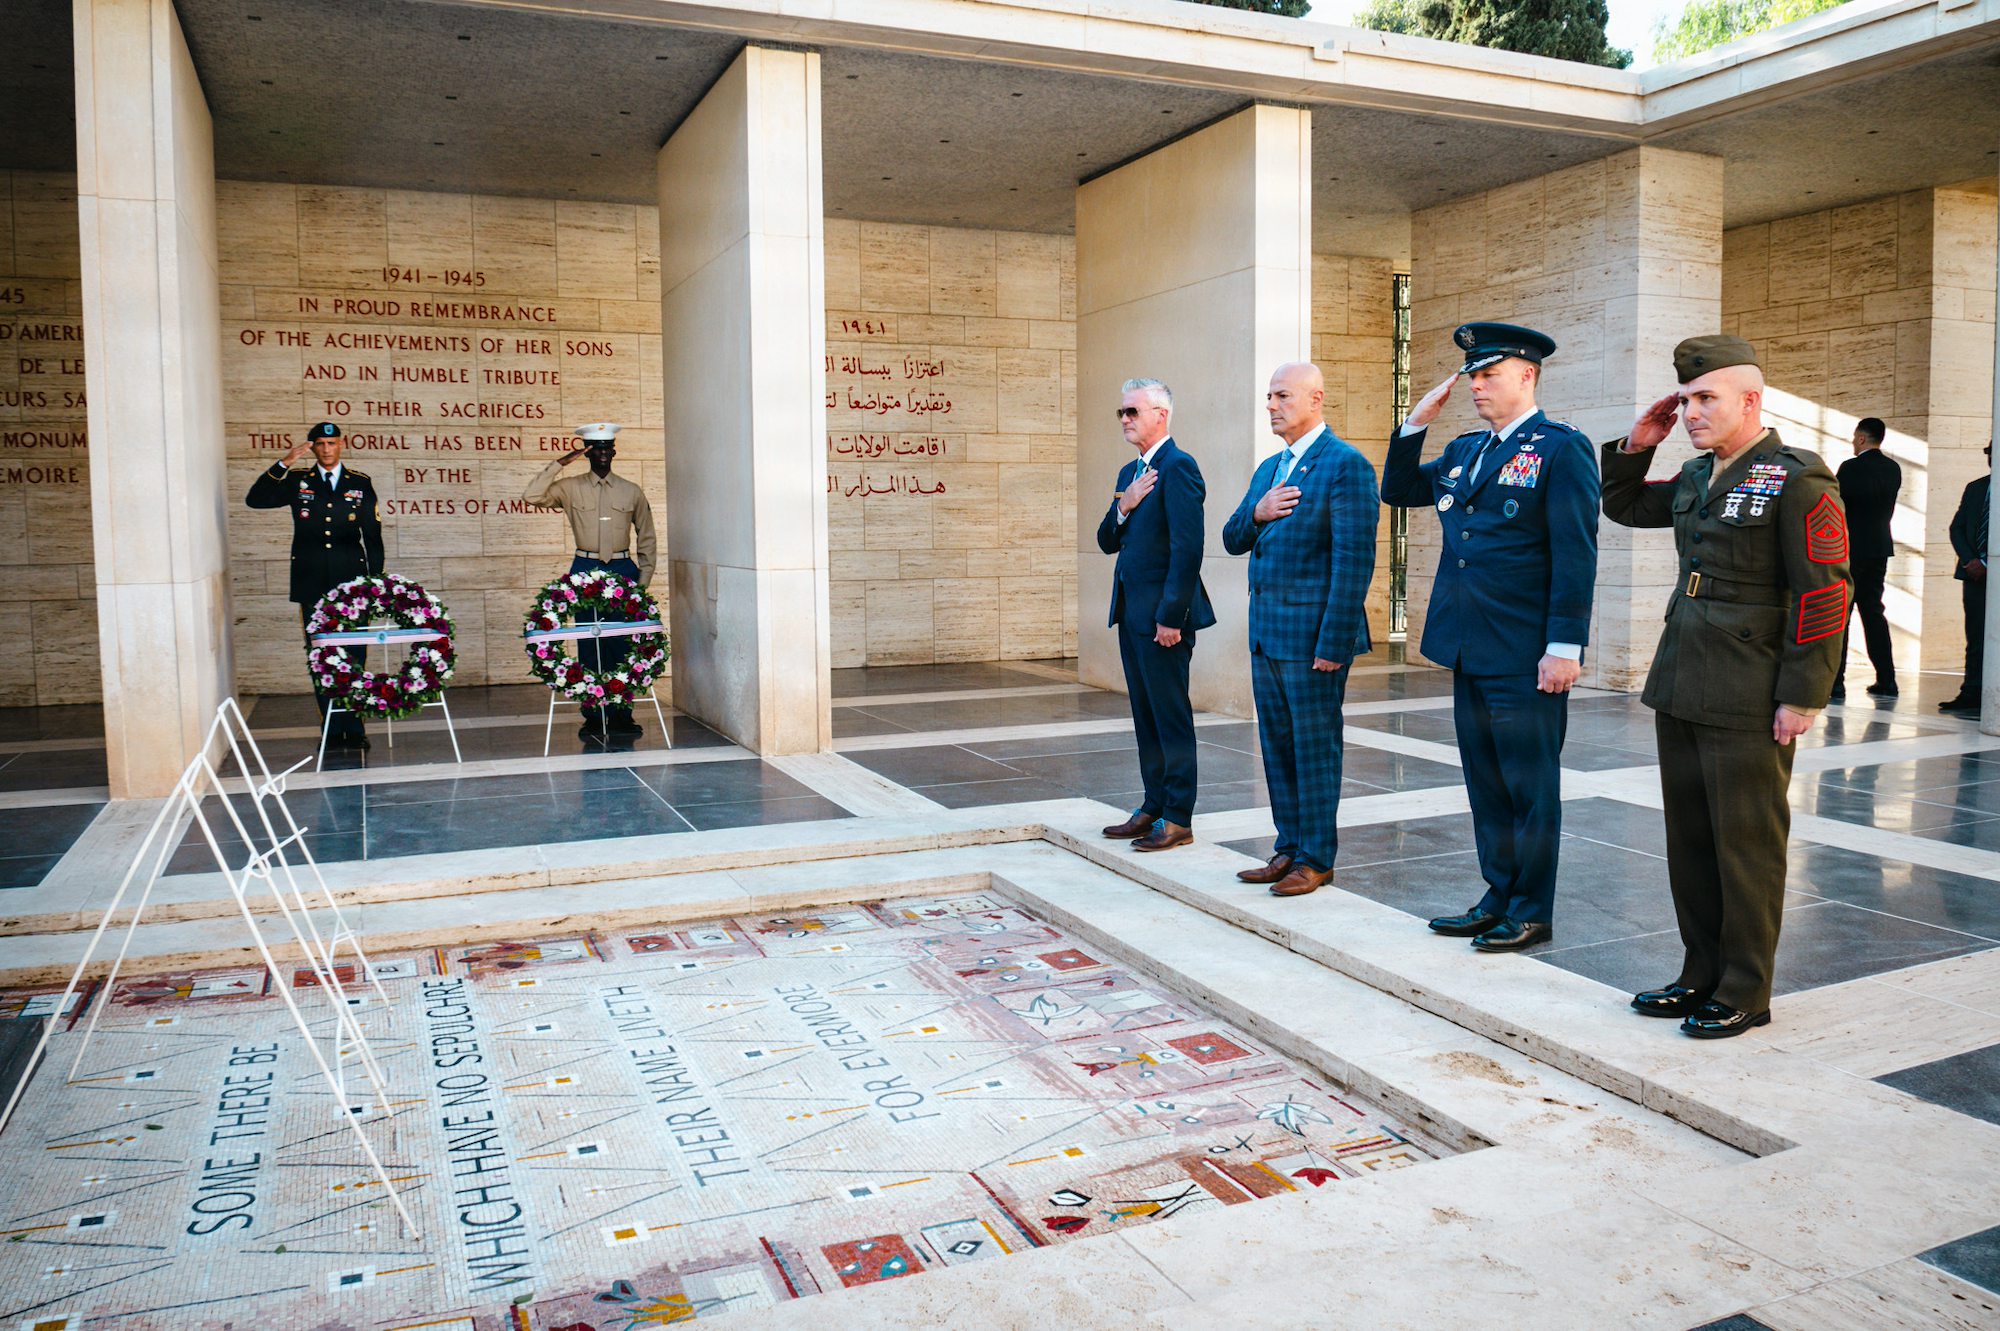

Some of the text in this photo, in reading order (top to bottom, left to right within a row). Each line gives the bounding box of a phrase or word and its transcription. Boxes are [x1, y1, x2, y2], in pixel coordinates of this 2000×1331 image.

[299, 297, 557, 322] IN PROUD REMEMBRANCE
[240, 329, 613, 357] OF THE ACHIEVEMENTS OF HER SONS
[20, 358, 46, 374] DE
[303, 365, 560, 385] AND IN HUMBLE TRIBUTE
[324, 400, 544, 419] TO THEIR SACRIFICES
[248, 433, 293, 449] THIS
[425, 435, 462, 450] HAS
[475, 436, 521, 450] BEEN
[405, 468, 471, 483] BY THE
[387, 499, 455, 514] STATES
[465, 499, 488, 514] OF
[774, 983, 941, 1123] FOR EVERMORE
[600, 984, 750, 1187] THEIR NAME LIVETH
[186, 1043, 278, 1236] SOME THERE BE
[423, 977, 536, 1293] WHICH HAVE NO SEPULCHRE
